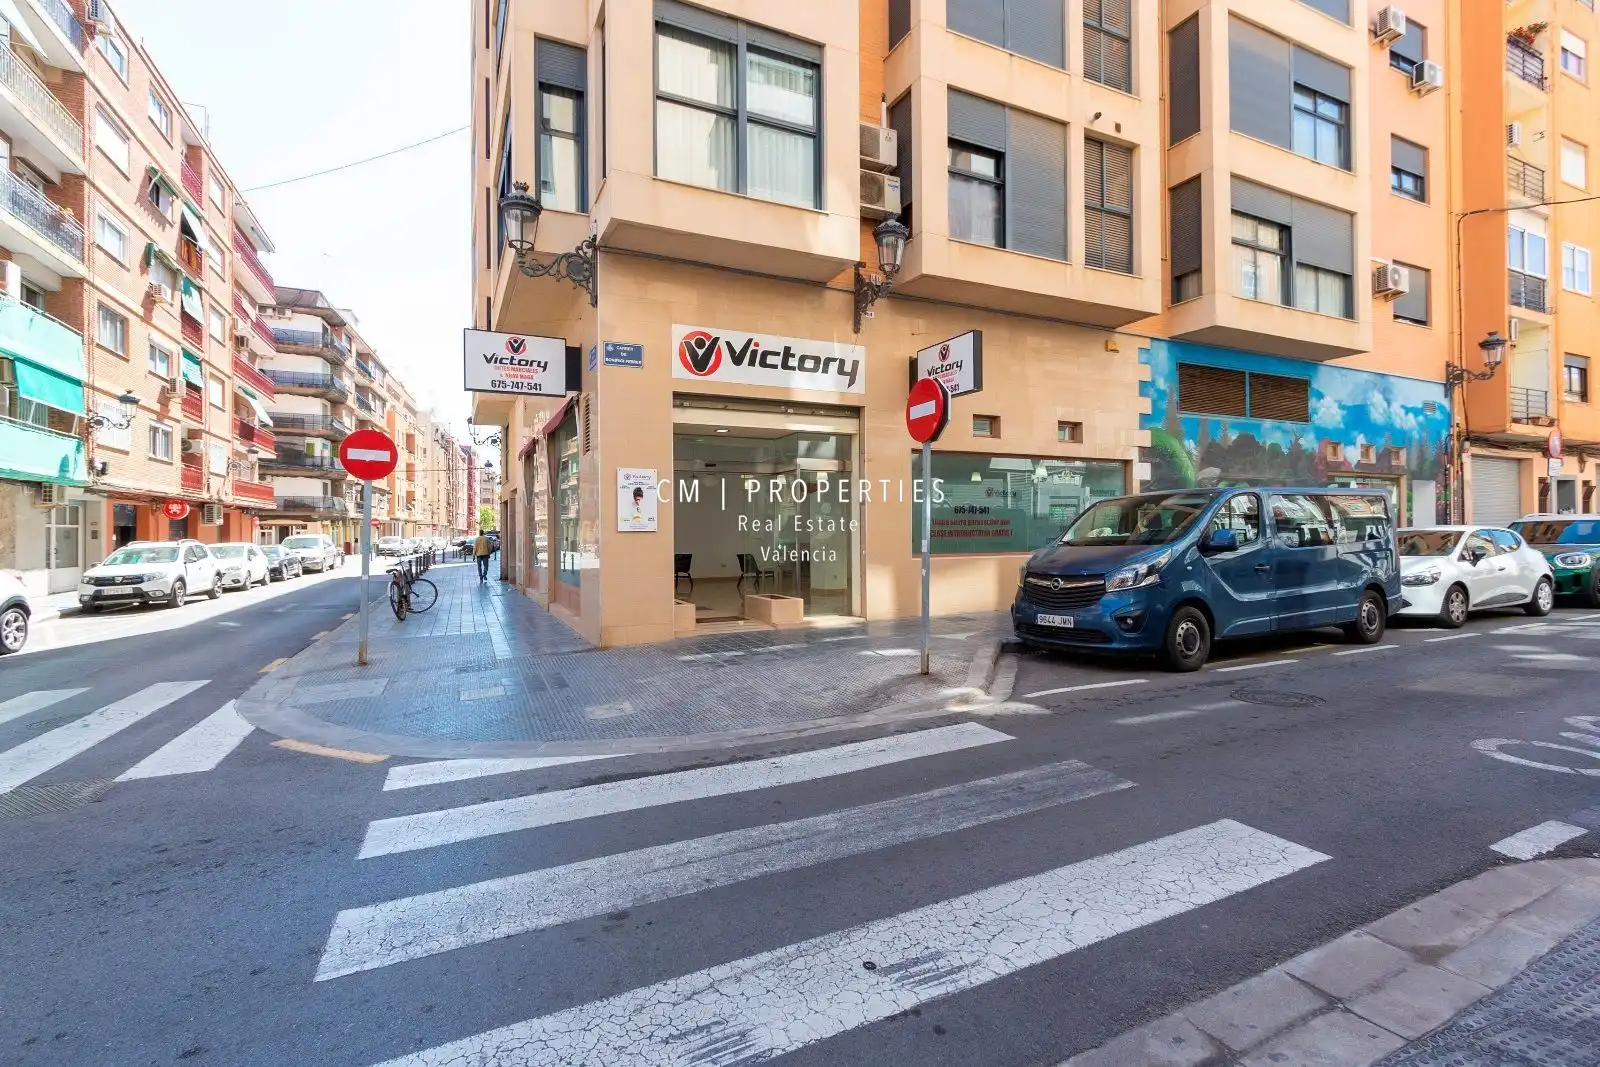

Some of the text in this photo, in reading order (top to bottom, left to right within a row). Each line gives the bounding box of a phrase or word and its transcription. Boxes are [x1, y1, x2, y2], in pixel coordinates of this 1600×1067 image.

[482, 352, 549, 373] Victory
[725, 337, 860, 389] Victory
[926, 359, 963, 377] Victory
[490, 379, 542, 392] 675-747-541
[993, 489, 1017, 498] Victory
